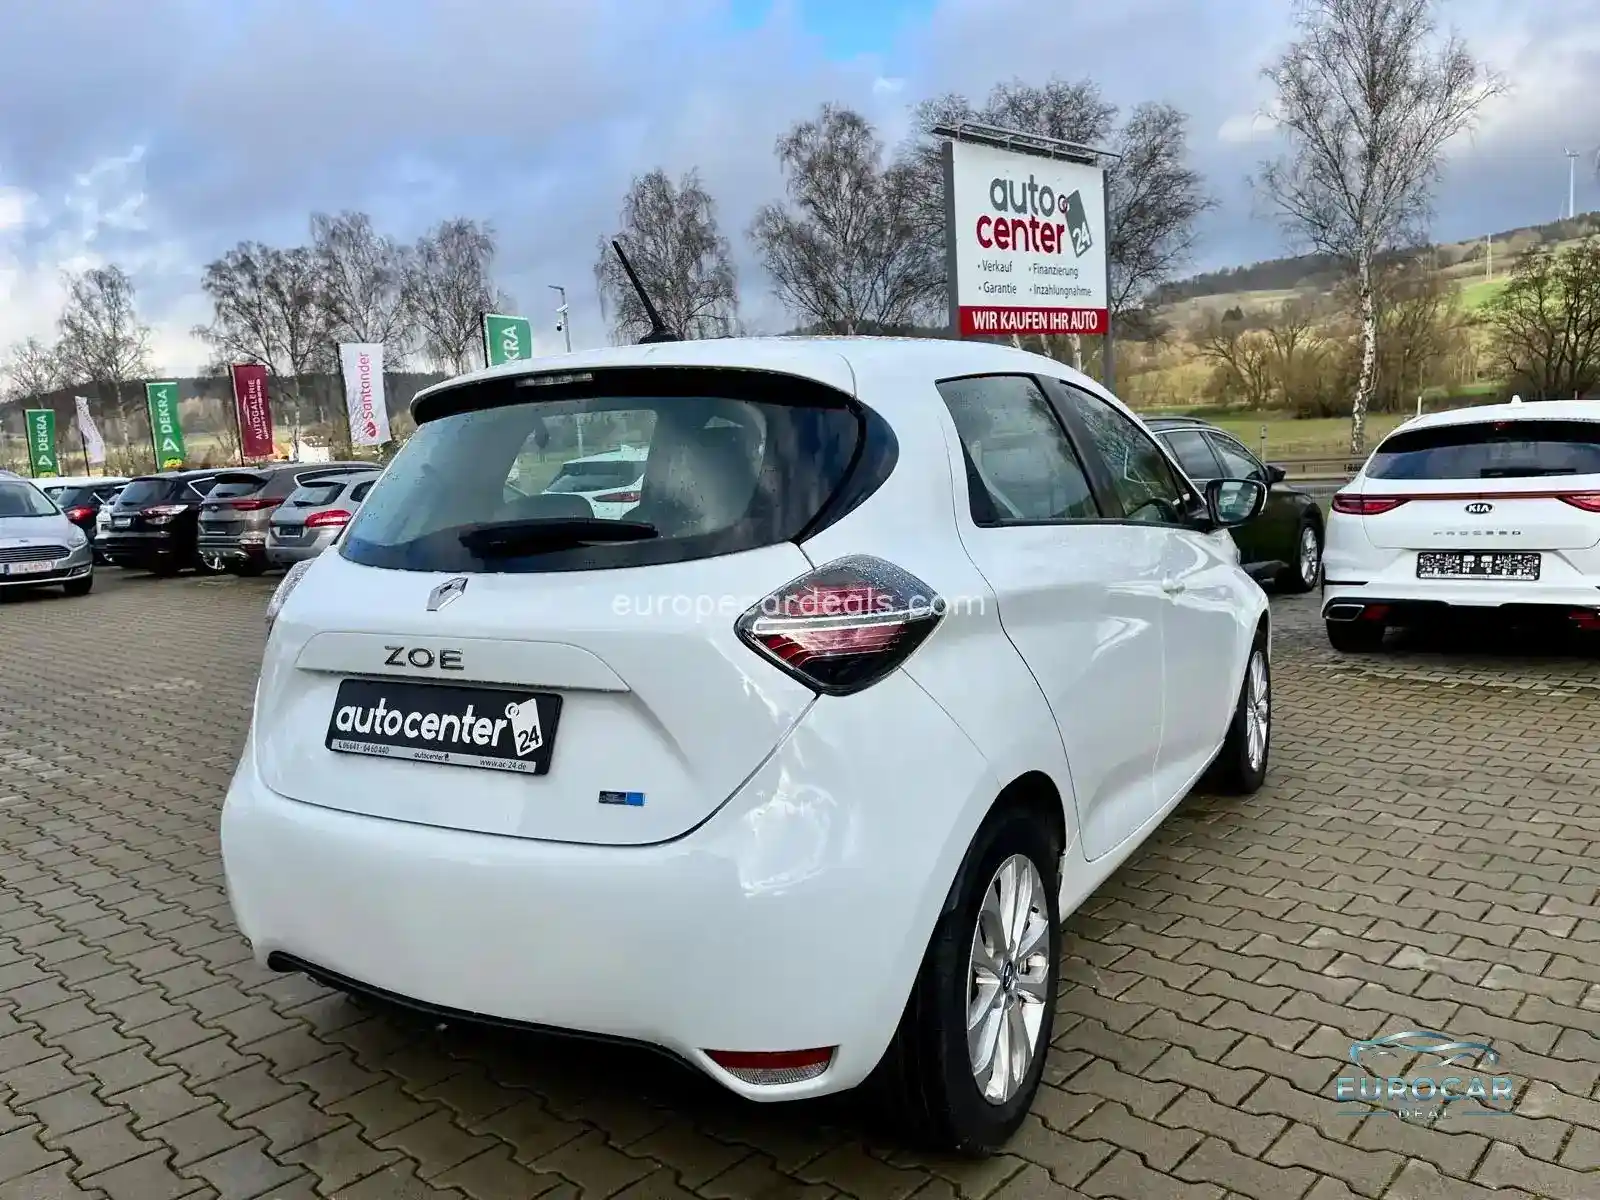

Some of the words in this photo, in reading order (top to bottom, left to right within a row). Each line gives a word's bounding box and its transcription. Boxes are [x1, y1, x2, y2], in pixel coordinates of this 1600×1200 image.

[989, 174, 1055, 217] auto
[976, 215, 1065, 254] center
[1072, 222, 1091, 253] 24
[982, 260, 1013, 273] Verkauf
[1033, 263, 1079, 280] Finanzierung
[983, 281, 1017, 295] Garantie
[1033, 285, 1092, 299] Inzahlungnahme
[972, 311, 998, 330] WIR
[1000, 311, 1048, 330] KAUFEN
[1050, 312, 1069, 330] IHR
[1070, 311, 1098, 330] AUTO
[501, 324, 520, 360] KRA
[358, 352, 374, 420] Santander
[156, 389, 173, 433] DEKRA
[247, 379, 263, 440] AUTOGALERIE
[36, 415, 49, 451] DEKRA
[1467, 504, 1491, 513] KIA
[383, 645, 465, 670] ZOE
[335, 697, 507, 747] autocenter
[517, 725, 540, 752] 24
